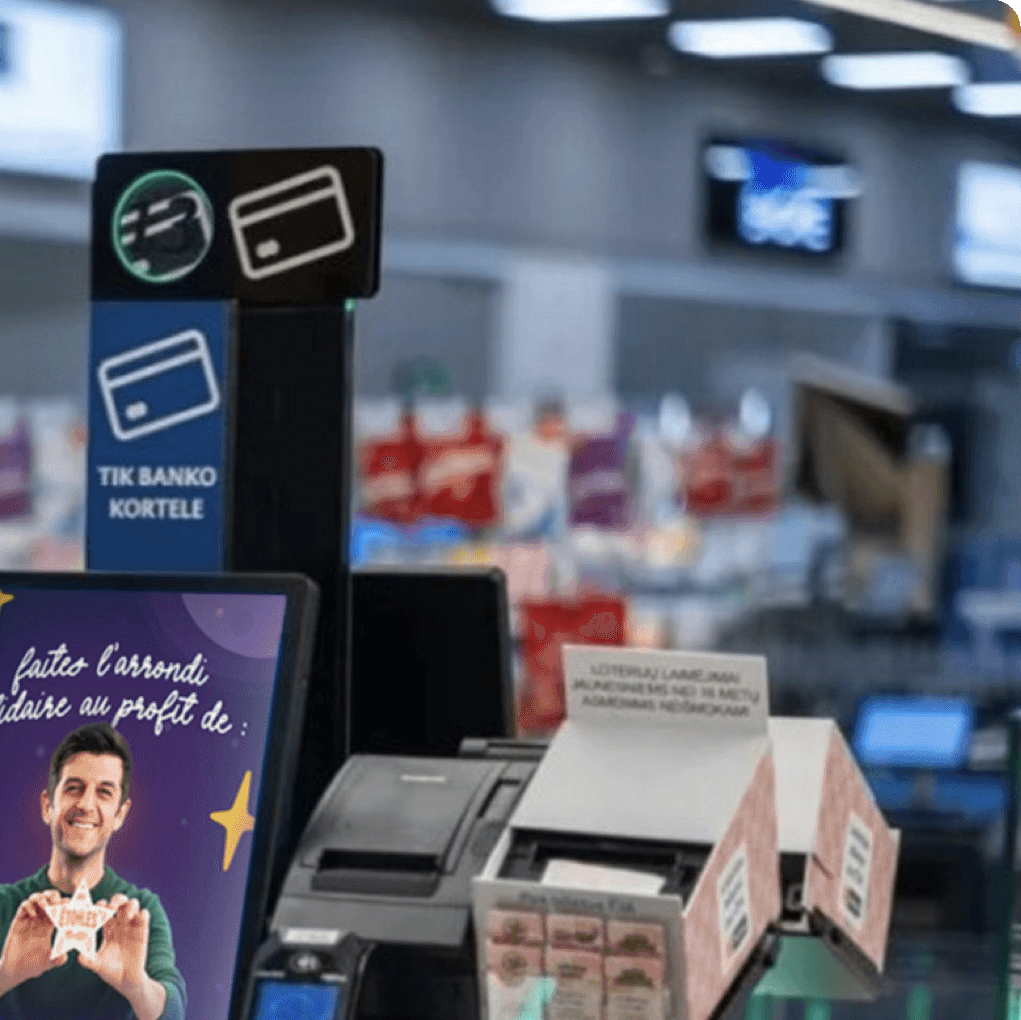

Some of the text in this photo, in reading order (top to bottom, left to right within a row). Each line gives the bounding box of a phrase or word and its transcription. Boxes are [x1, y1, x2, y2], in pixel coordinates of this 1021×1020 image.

[98, 466, 217, 487] TIK BANKO
[109, 497, 205, 519] KORTELE
[11, 642, 210, 696] faites l'arrondi
[79, 696, 111, 716] au
[110, 690, 199, 736] profit
